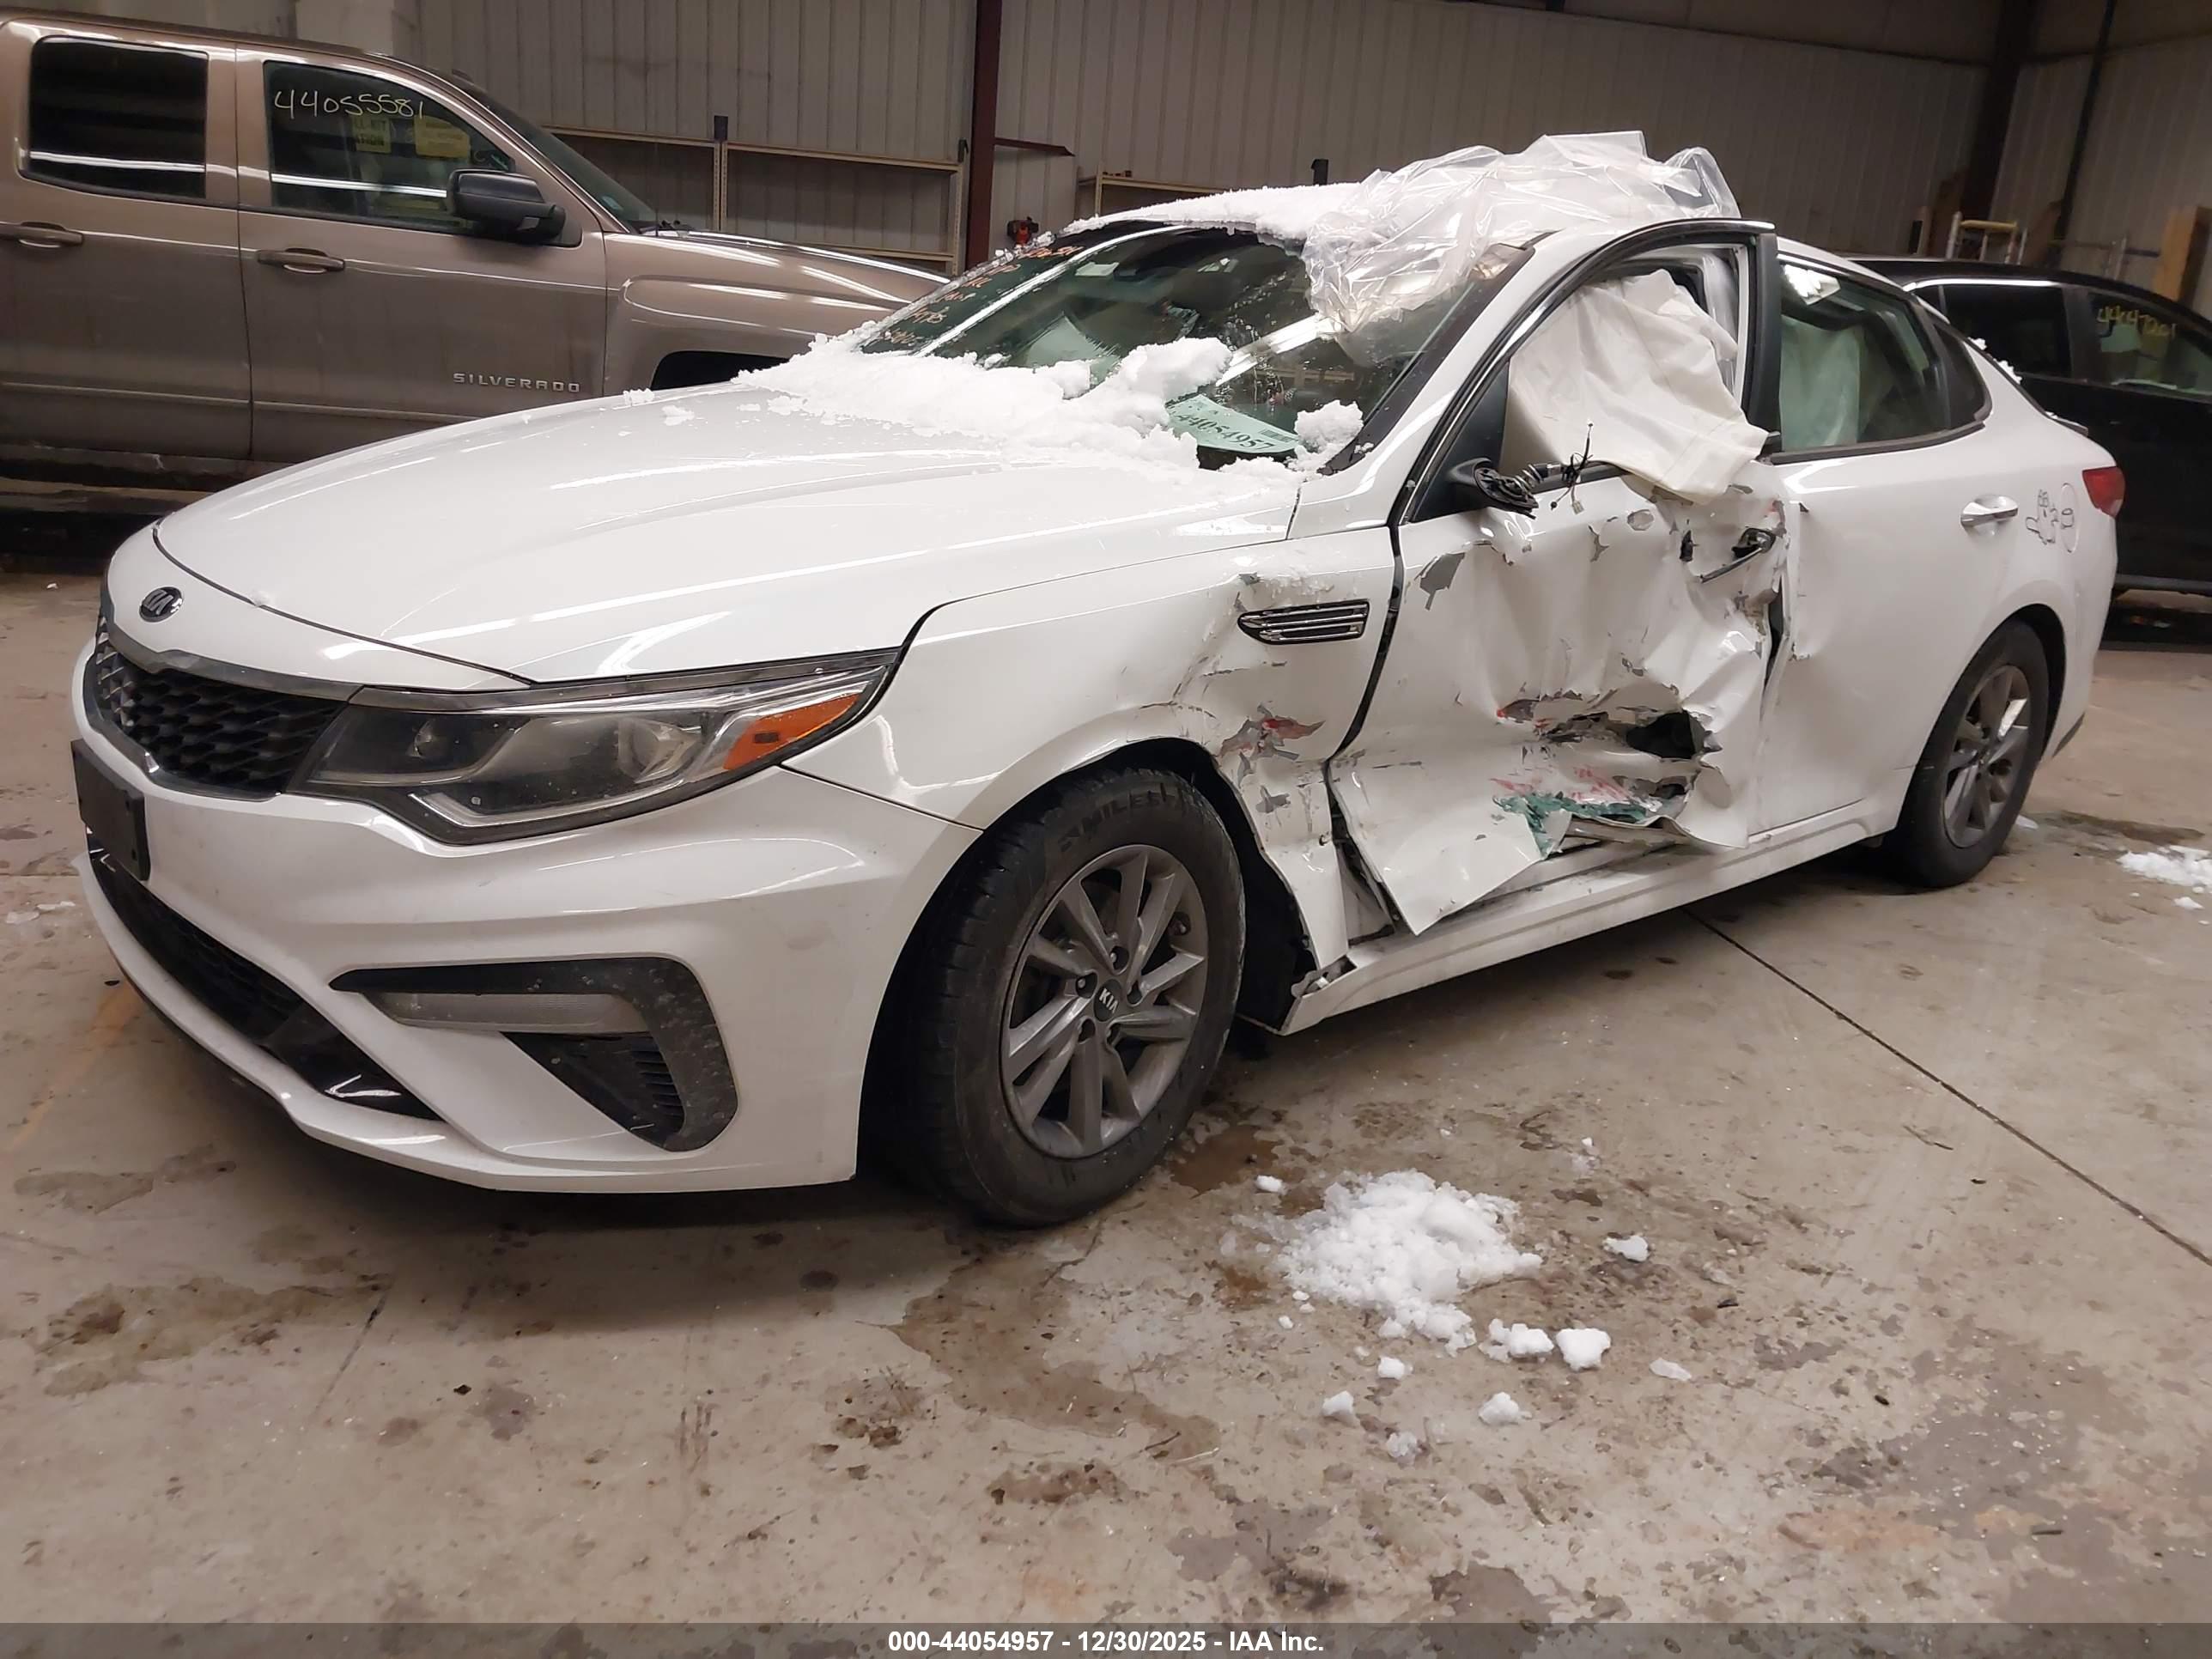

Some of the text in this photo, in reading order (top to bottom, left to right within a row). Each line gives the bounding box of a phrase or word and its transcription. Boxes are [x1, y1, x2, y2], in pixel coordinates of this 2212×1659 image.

[274, 89, 423, 119] 44055581
[453, 372, 580, 392] SILVERADO
[1099, 988, 1118, 1014] KIA
